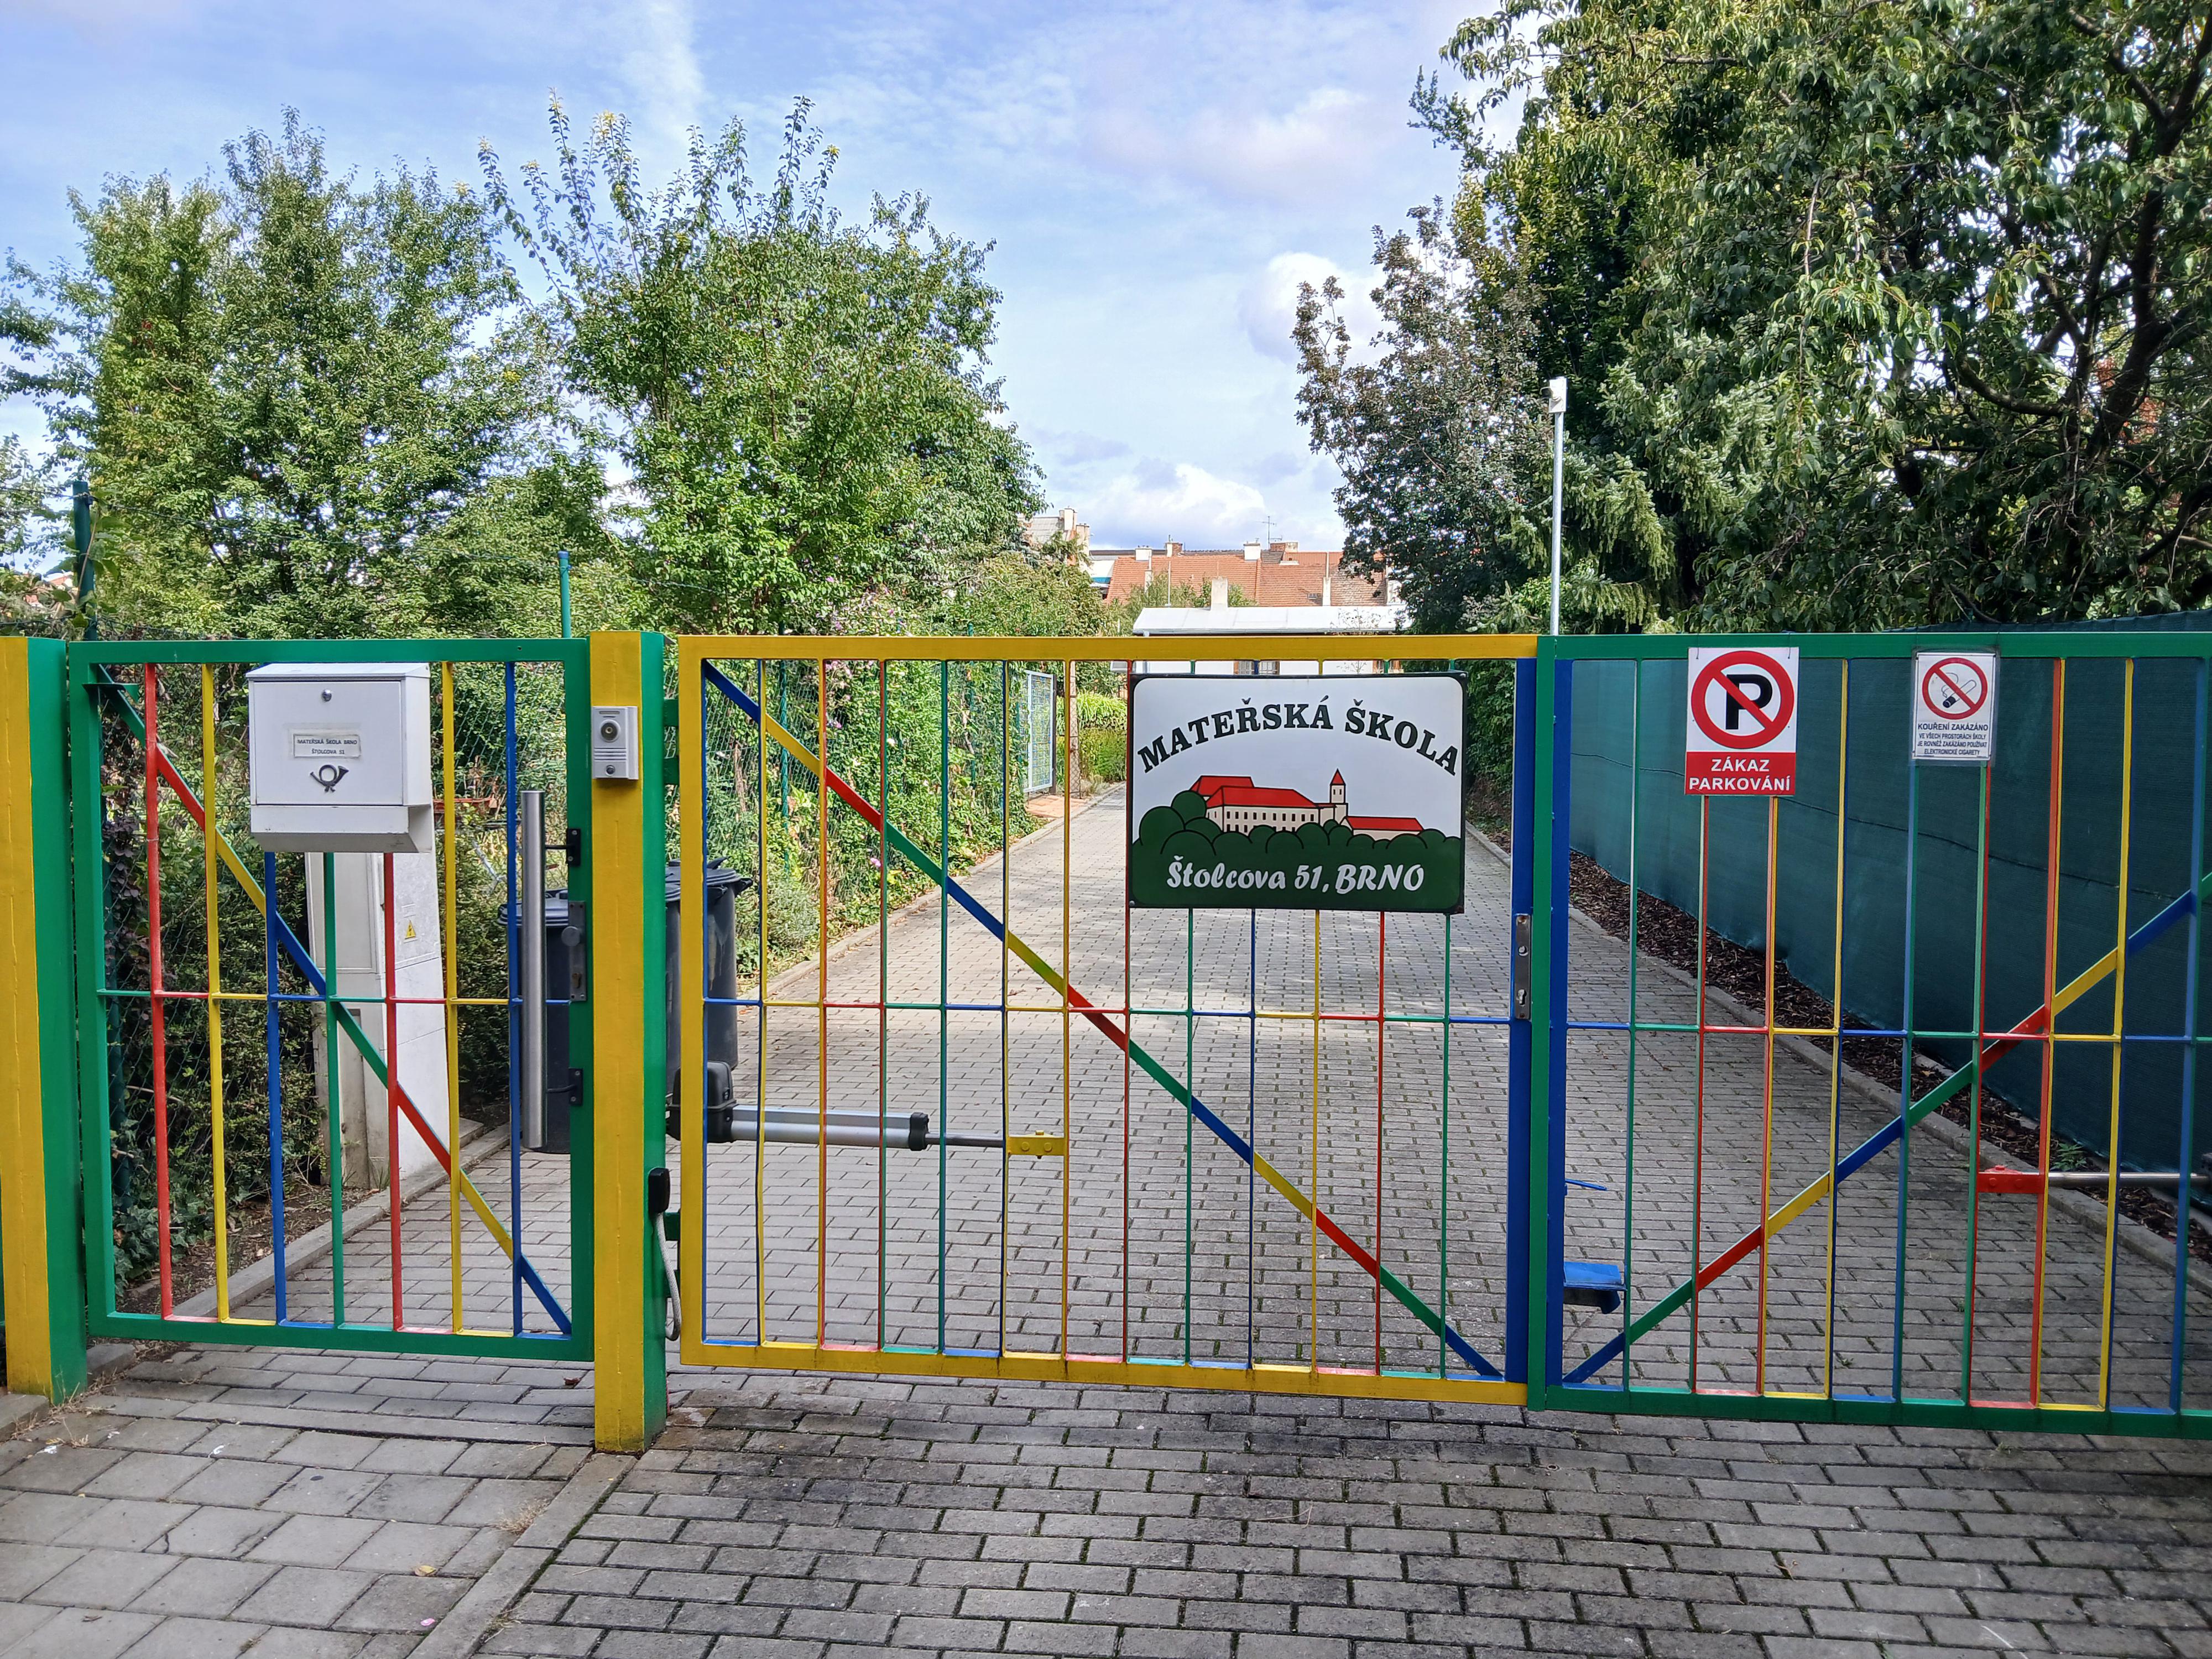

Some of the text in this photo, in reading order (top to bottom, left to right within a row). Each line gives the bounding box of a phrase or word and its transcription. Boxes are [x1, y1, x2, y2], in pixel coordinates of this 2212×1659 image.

[1918, 722, 1989, 731] KOUŘENÍ ZAKÁZÁNO
[1138, 695, 1459, 776] MATEŘSKÁ ŠKOLA
[1711, 757, 1770, 772] ZÁKAZ
[1689, 775, 1791, 791] PARKOVÁNÍ
[1166, 855, 1425, 894] Štolcova 51, BRNO
